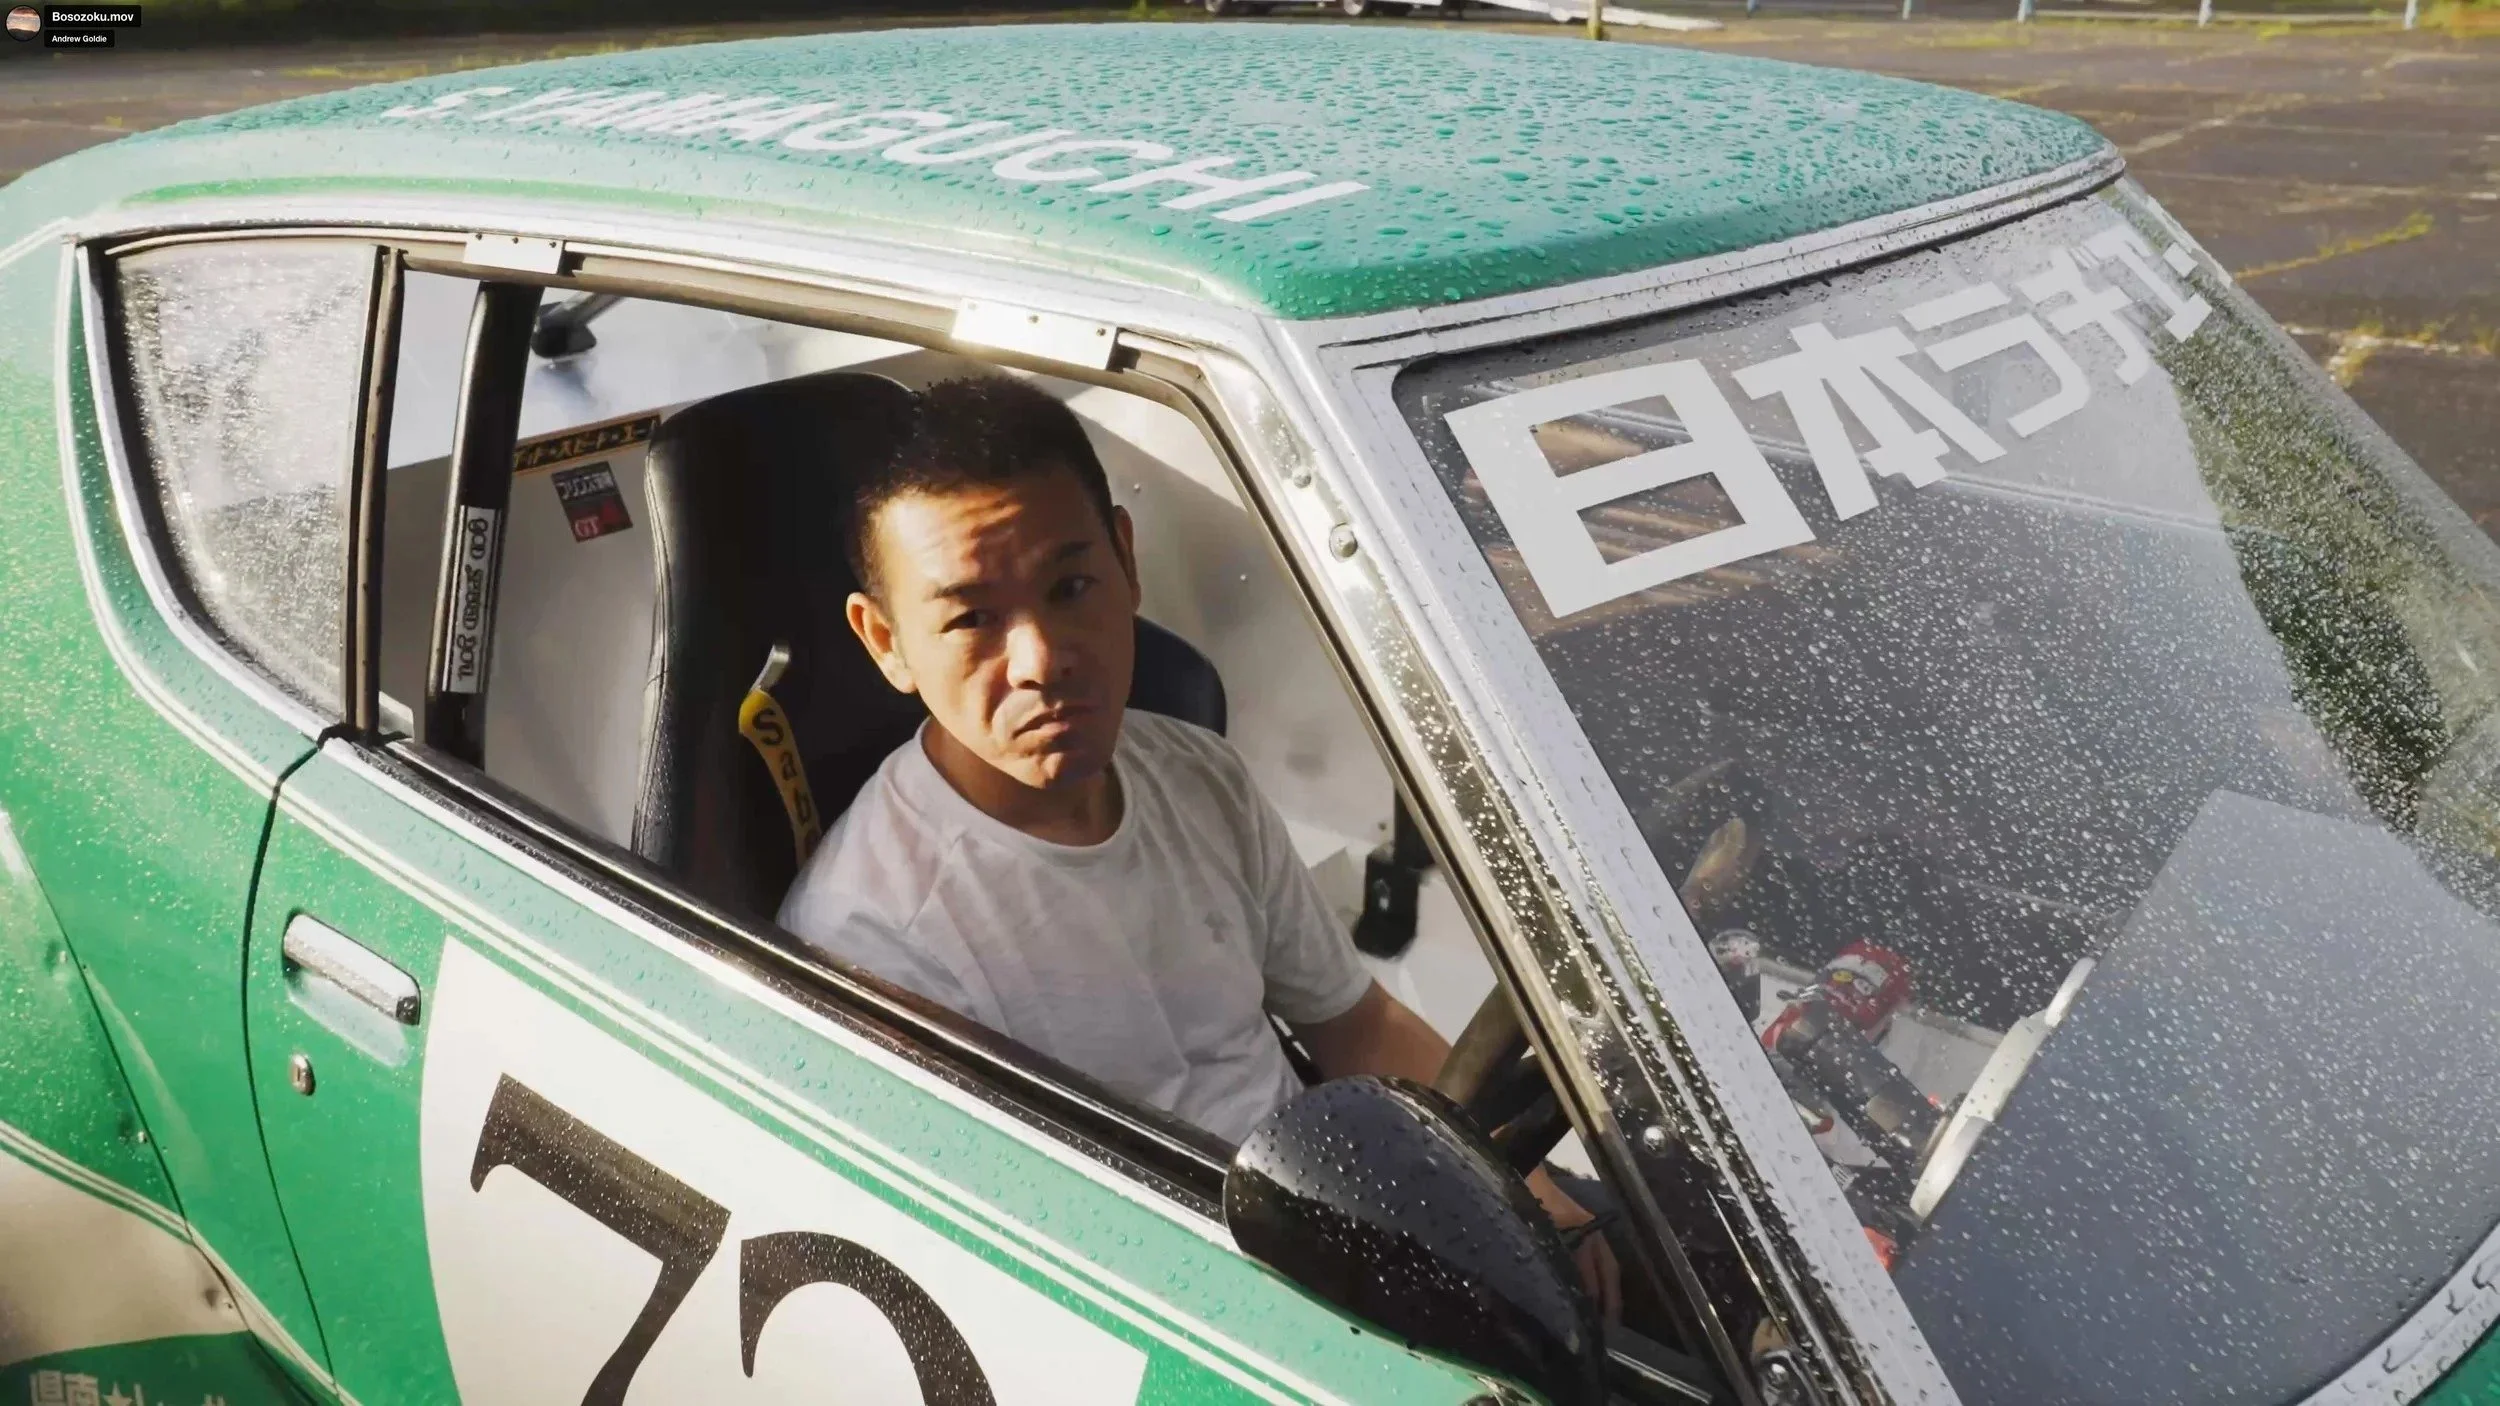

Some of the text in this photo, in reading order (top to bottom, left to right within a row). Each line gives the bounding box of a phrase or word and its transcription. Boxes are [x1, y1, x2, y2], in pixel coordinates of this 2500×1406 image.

[473, 86, 1371, 222] YAMAGUCHI
[1443, 222, 2212, 620] 日本ラヂエ
[752, 707, 815, 835] Sab
